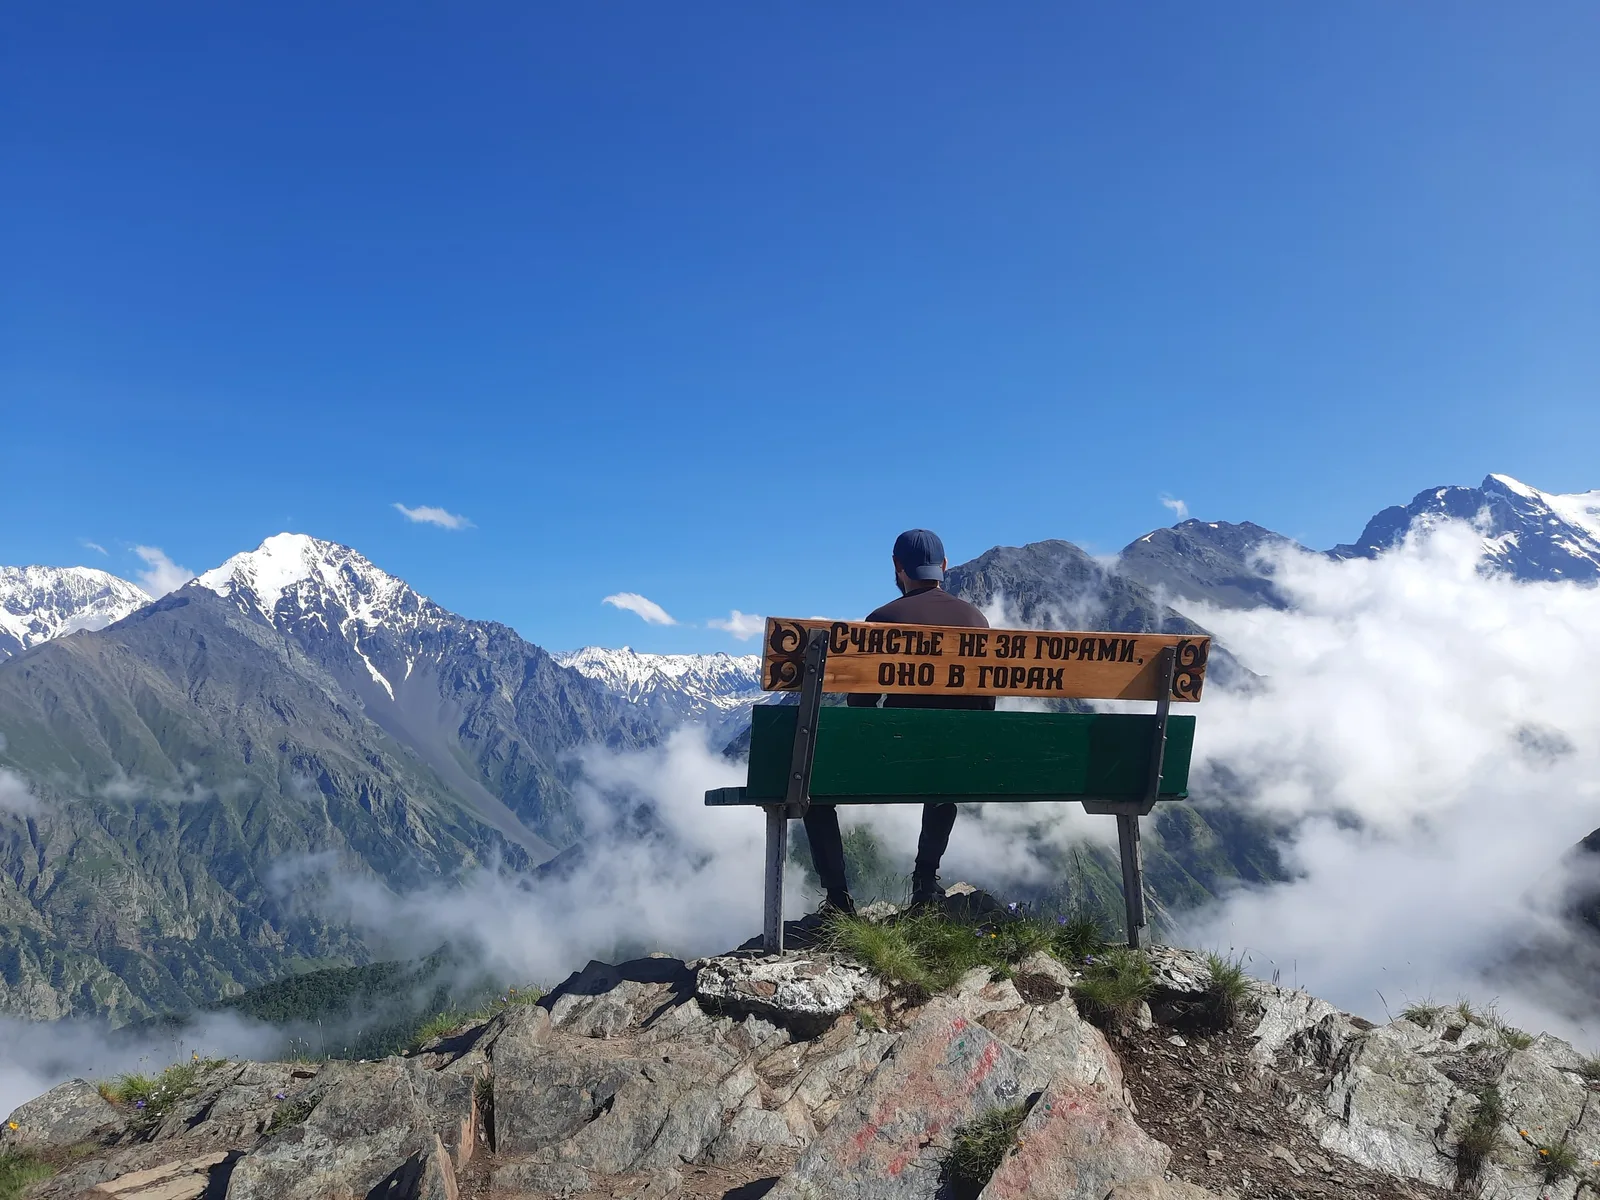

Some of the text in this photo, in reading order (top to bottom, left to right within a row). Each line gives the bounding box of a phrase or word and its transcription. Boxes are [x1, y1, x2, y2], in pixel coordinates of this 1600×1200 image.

[958, 633, 988, 658] НЕ
[996, 635, 1027, 659] ЗА
[1034, 635, 1143, 665] ГОРАМИ,
[878, 662, 1065, 690] ОНО В ГОРАХ
